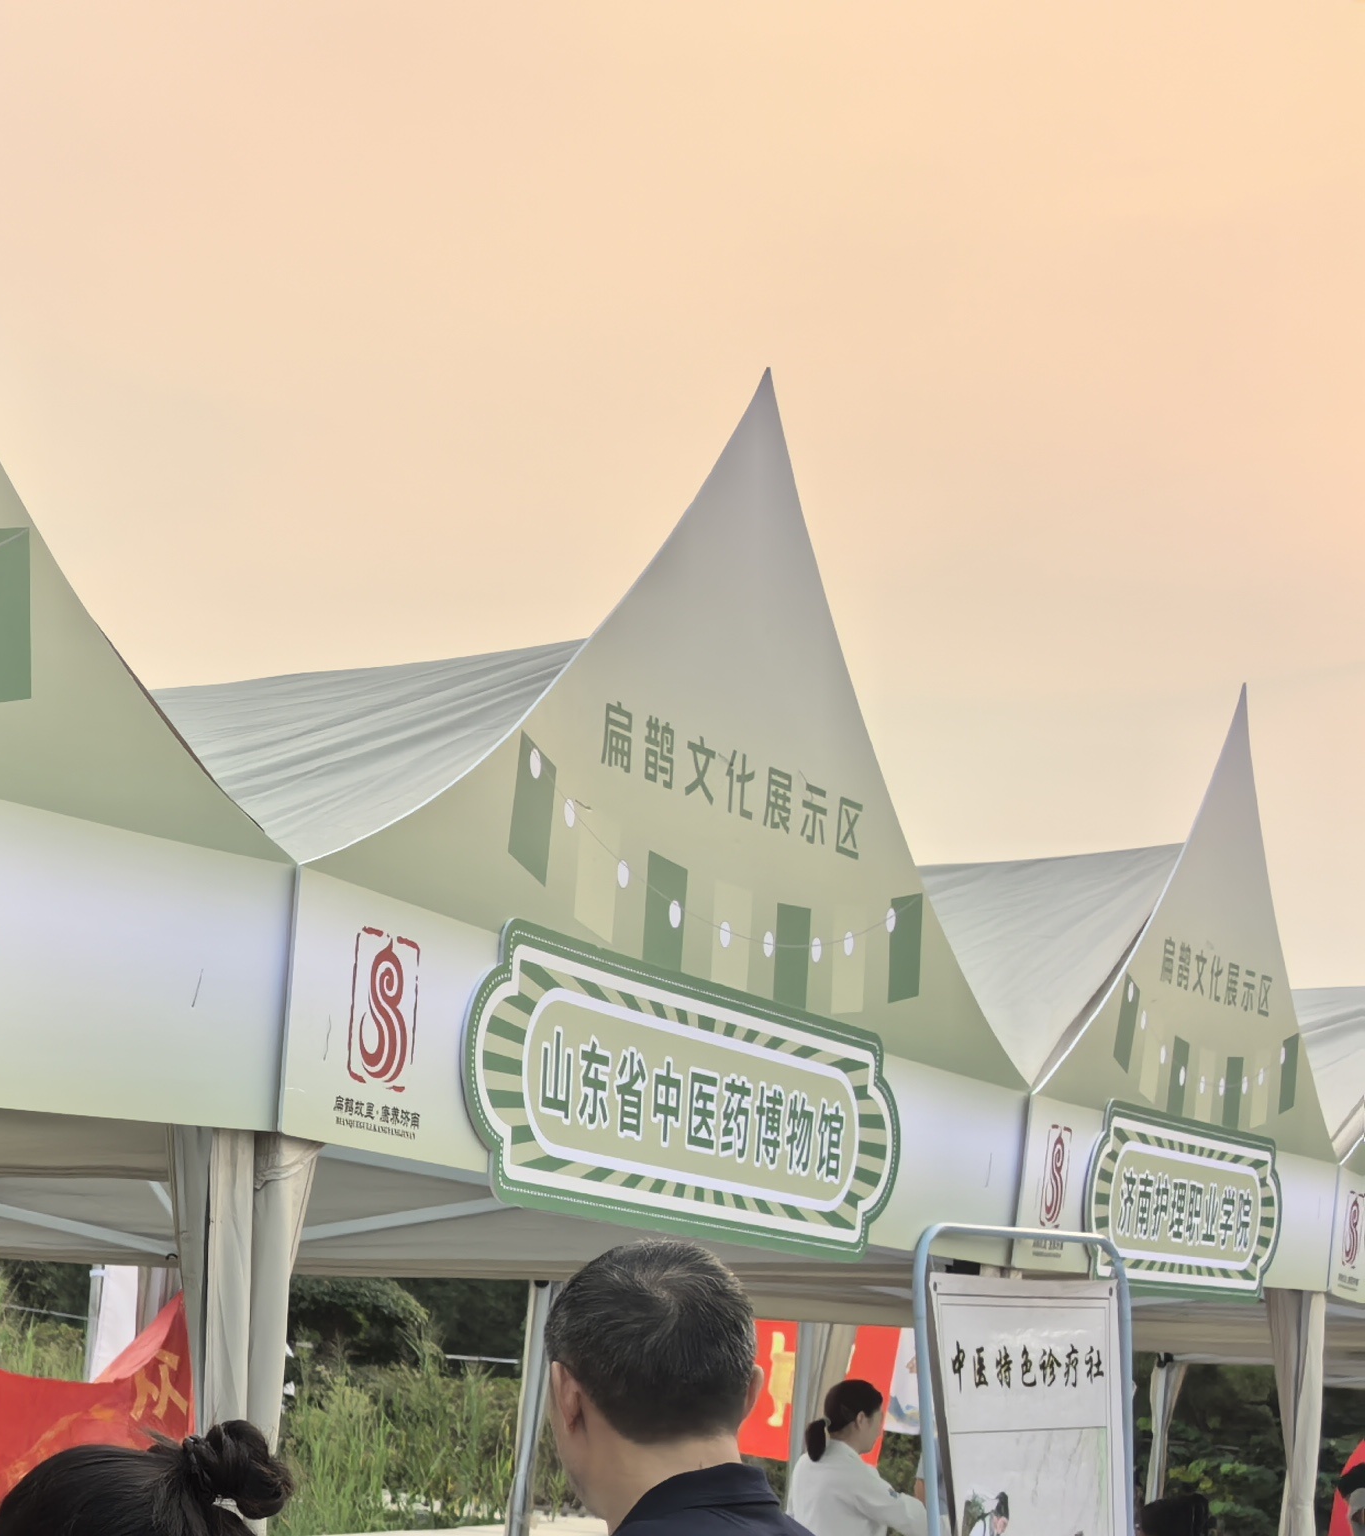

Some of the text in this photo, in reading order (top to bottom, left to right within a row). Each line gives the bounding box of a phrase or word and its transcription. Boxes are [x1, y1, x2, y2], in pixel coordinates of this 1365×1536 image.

[600, 701, 864, 860] 扁鹊文化展示区
[539, 1026, 845, 1183] 山东省中医药博物馆
[950, 1339, 1105, 1394] 中医特色诊疗社
